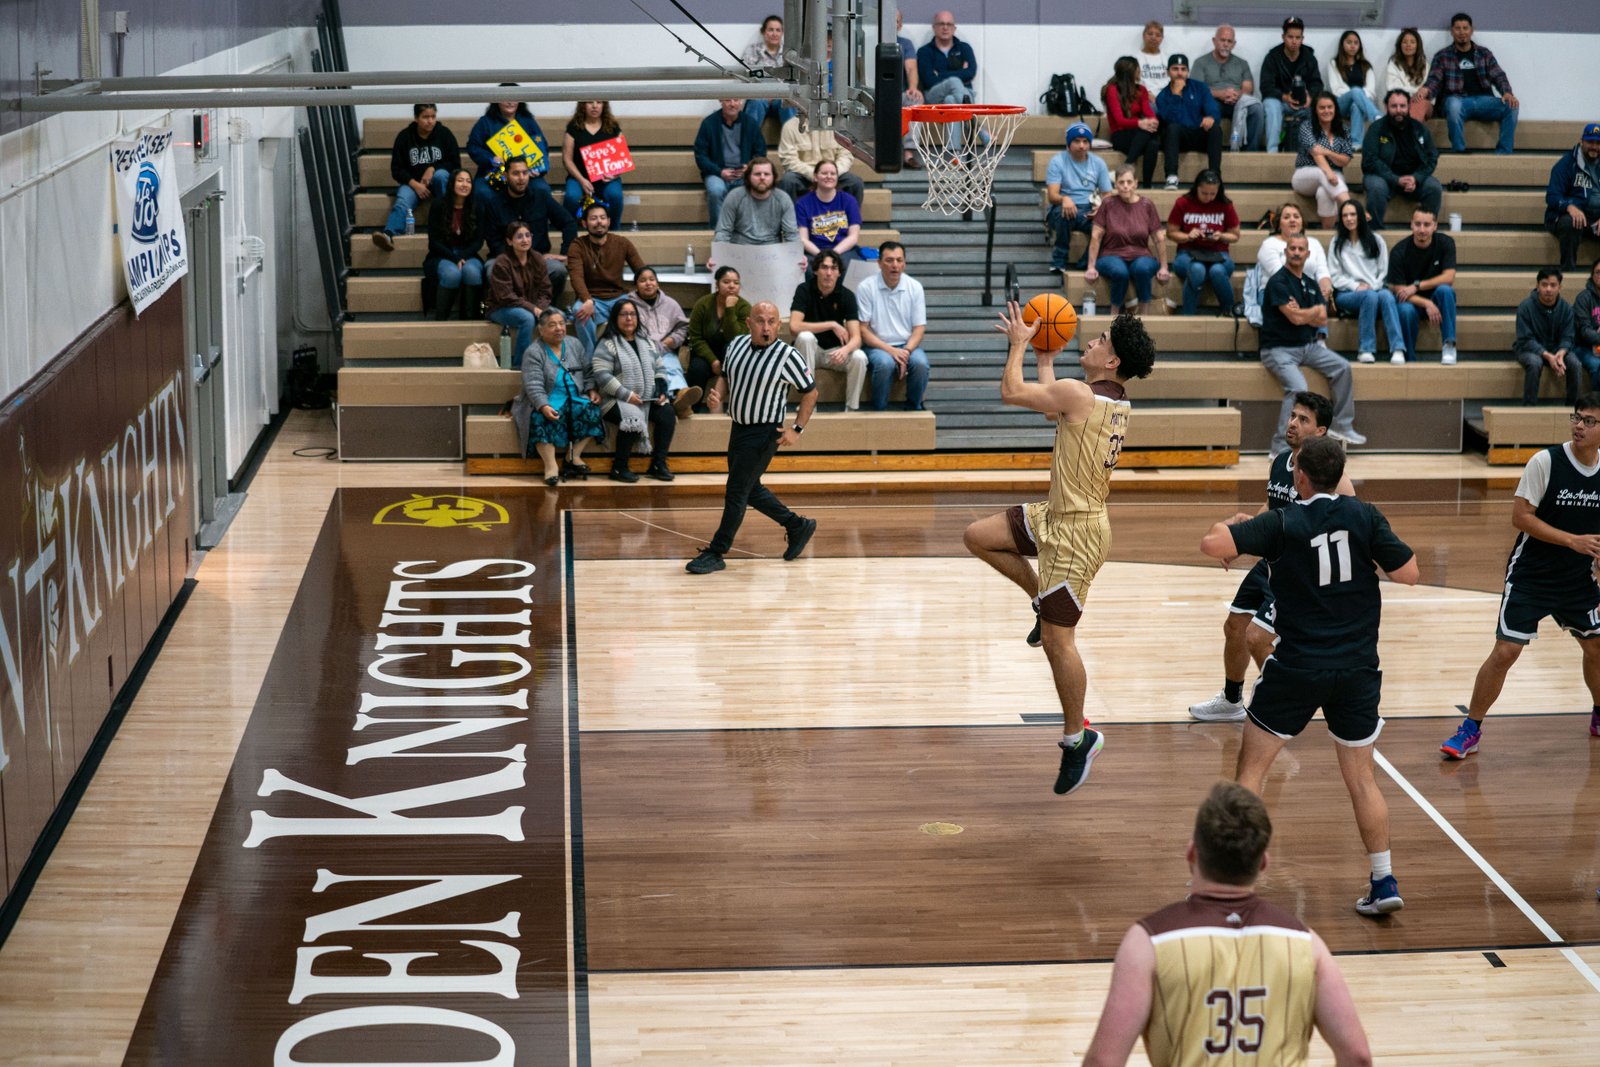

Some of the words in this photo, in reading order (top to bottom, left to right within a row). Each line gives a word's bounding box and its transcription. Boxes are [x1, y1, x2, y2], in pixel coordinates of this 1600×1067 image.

[410, 146, 442, 166] GAP
[580, 144, 617, 161] Pepe's
[58, 369, 187, 665] KNIGHTS
[1557, 489, 1573, 500] Los
[1573, 489, 1599, 502] Angeles
[1310, 529, 1352, 587] 11
[242, 558, 536, 848] KNIGHTS
[1204, 987, 1268, 1055] 35
